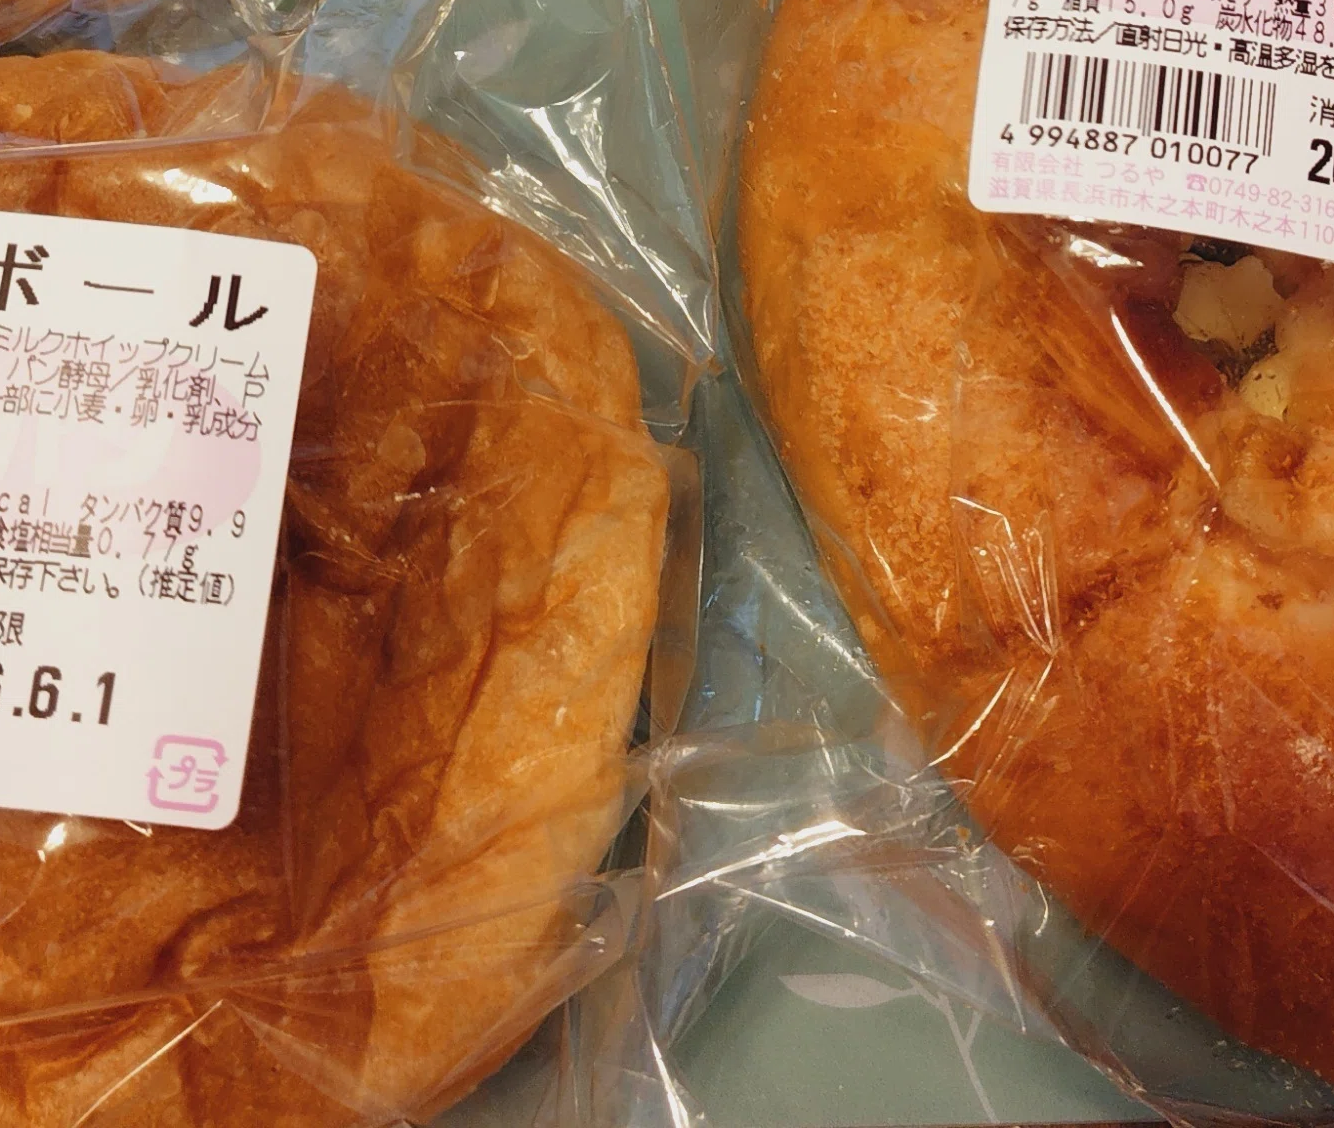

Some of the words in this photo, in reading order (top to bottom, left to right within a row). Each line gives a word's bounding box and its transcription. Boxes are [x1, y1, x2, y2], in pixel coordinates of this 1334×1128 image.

[991, 150, 1084, 178] 有限会社
[1095, 160, 1165, 186] つるや
[1000, 123, 1014, 145] 4
[1028, 124, 1137, 156] 994887
[1151, 137, 1259, 174] 010077
